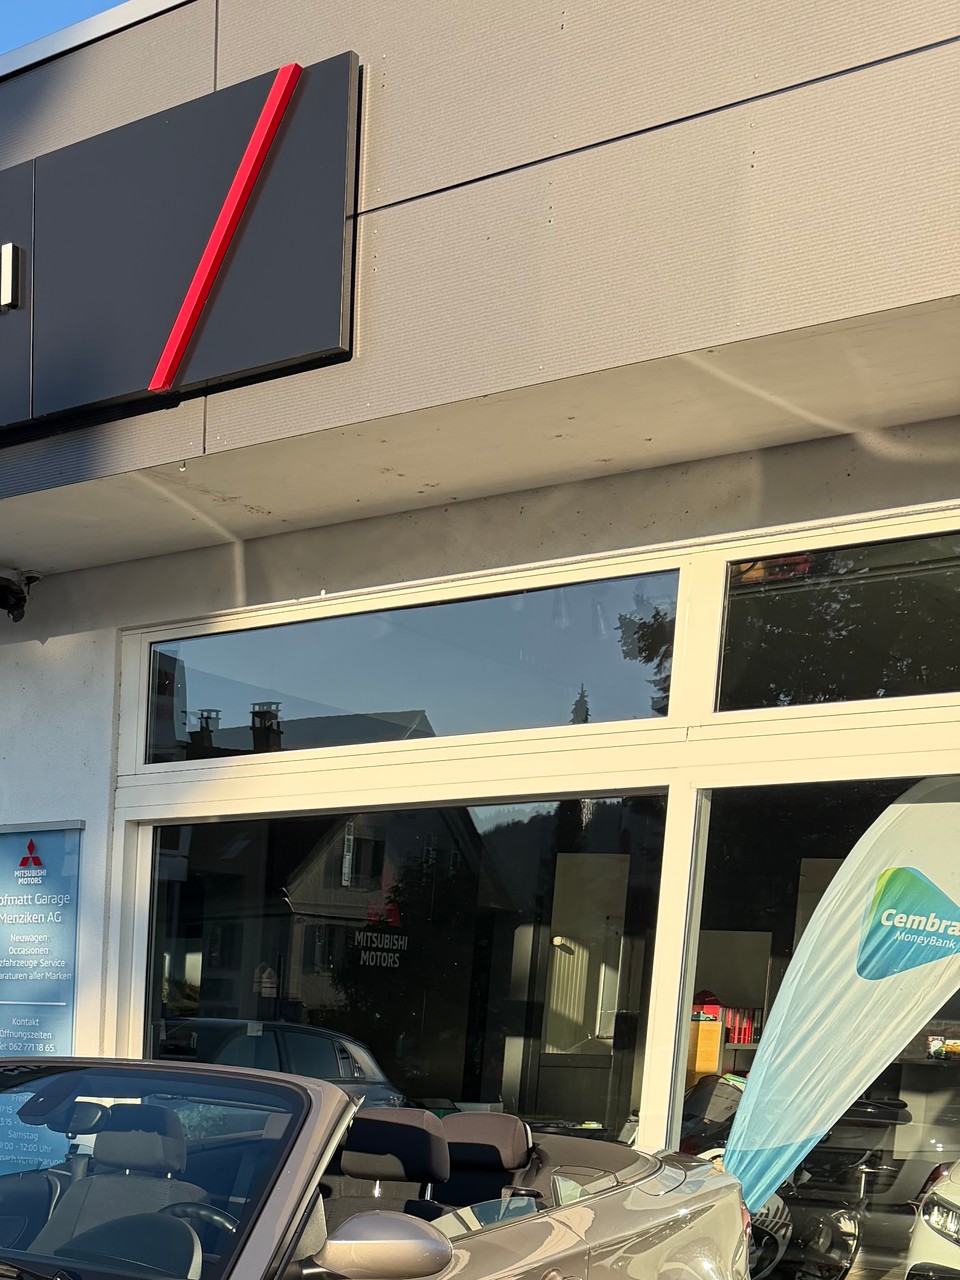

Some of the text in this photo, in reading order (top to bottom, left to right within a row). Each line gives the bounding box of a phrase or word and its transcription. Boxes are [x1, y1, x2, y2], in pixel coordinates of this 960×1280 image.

[14, 869, 47, 877] MITSUBISHI
[18, 877, 42, 885] MOTORS
[34, 893, 71, 907] Garage
[46, 911, 62, 923] AG
[881, 909, 960, 936] Cembra
[10, 933, 48, 943] Neuwagen
[354, 931, 409, 951] MITSUBISHI
[895, 930, 957, 949] MoneyBank
[8, 946, 49, 955] Occasionen
[40, 958, 66, 968] Service
[360, 950, 400, 968] MOTORS
[45, 971, 72, 980] Marken
[11, 1017, 40, 1027] Kontakt
[0, 1027, 52, 1041] Öffnungszeiten
[9, 1042, 22, 1051] 062
[45, 1043, 55, 1052] 65
[7, 1129, 39, 1141] Samstag
[39, 1144, 52, 1153] Uhr
